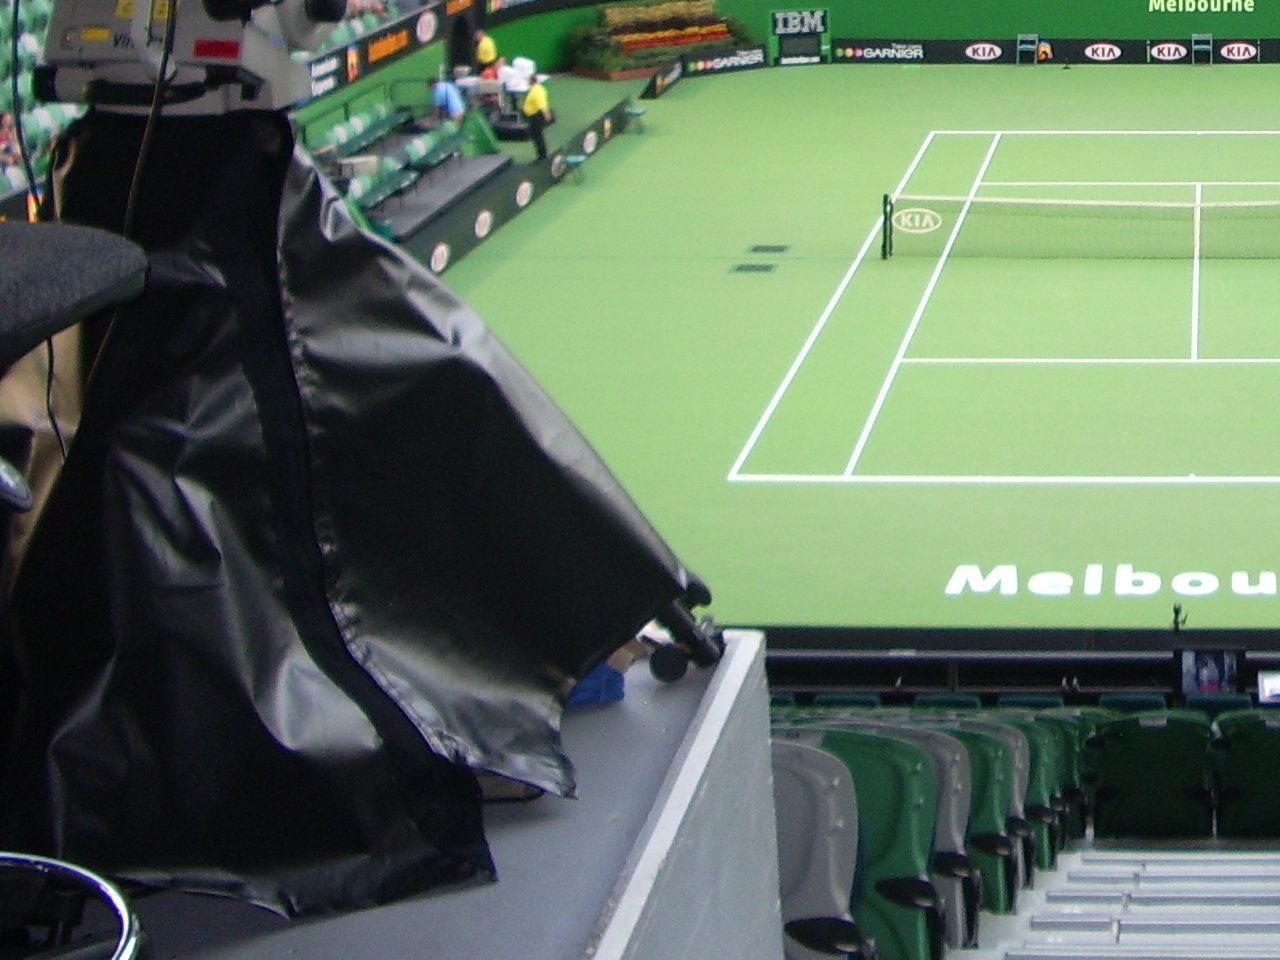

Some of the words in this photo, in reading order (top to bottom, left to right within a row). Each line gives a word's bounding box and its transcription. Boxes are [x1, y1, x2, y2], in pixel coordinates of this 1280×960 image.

[775, 10, 825, 34] IBM
[863, 47, 924, 59] GARNIER
[972, 47, 995, 57] KIA
[1091, 47, 1115, 57] KIA
[1157, 47, 1181, 57] KIA
[1226, 47, 1250, 57] KIA
[901, 214, 934, 227] KIA
